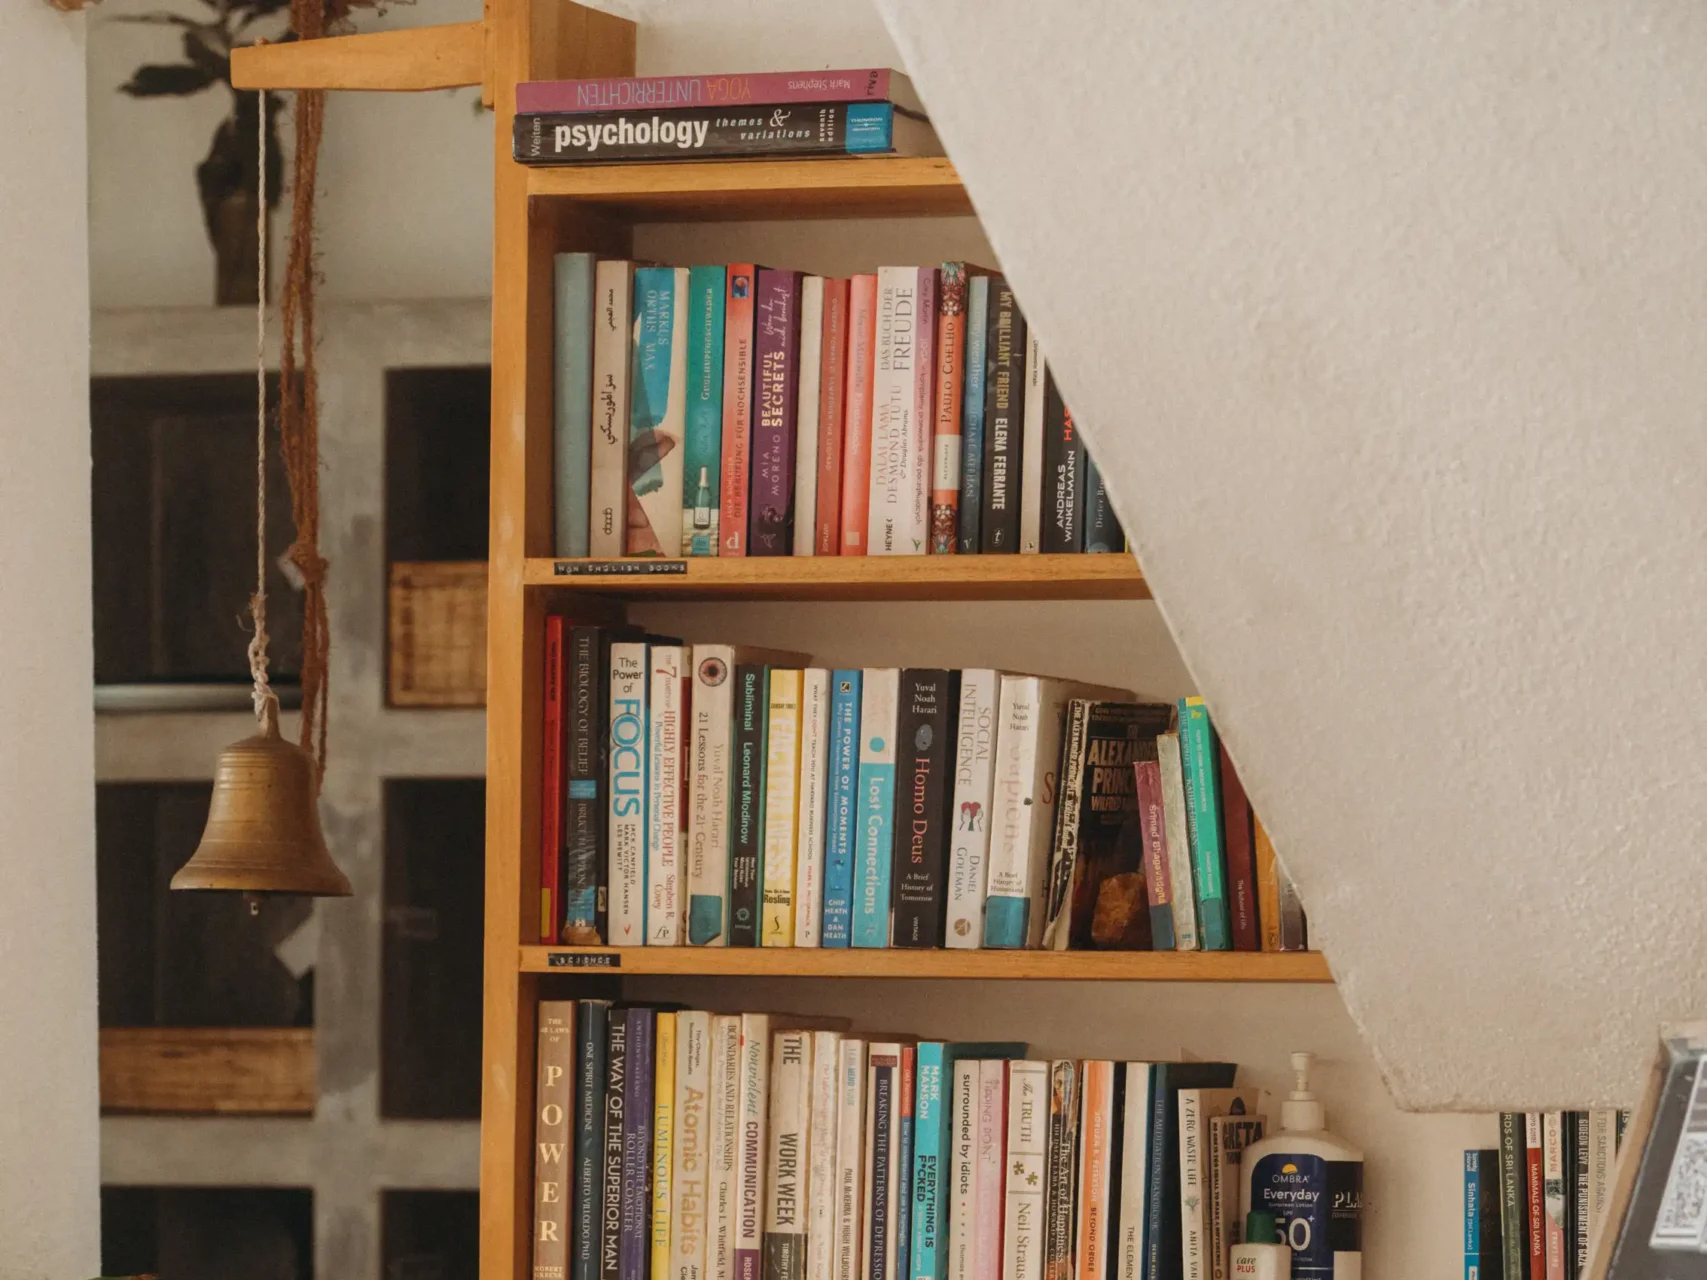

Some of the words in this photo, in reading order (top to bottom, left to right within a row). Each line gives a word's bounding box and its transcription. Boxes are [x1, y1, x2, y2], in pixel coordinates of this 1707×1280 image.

[577, 79, 700, 106] UNTERRICHTEN
[706, 78, 752, 101] YOGA
[787, 78, 823, 91] Stephens
[824, 77, 851, 90] Mark
[530, 116, 542, 156] Weiten
[554, 117, 709, 153] psychology
[715, 116, 763, 128] themes
[769, 108, 791, 127] &
[740, 127, 811, 140] variations
[658, 289, 671, 346] MARKUS
[883, 287, 893, 312] DER
[1000, 291, 1013, 307] MY
[881, 314, 892, 346] BUCH
[893, 287, 913, 372] FREUDE
[942, 322, 954, 375] COELHO
[997, 310, 1012, 366] BRILLIANT
[880, 348, 892, 371] DAS
[761, 352, 773, 428] BEAUTIFUL
[772, 351, 784, 428] SECRETS
[941, 381, 953, 424] PAULO
[995, 370, 1009, 409] FRIEND
[994, 417, 1008, 453] ELENA
[771, 433, 782, 497] MORENO
[992, 455, 1007, 511] FERRANTE
[1056, 464, 1066, 529] ANDREAS
[1065, 450, 1076, 542] WINKELMANN
[588, 562, 640, 574] ENGLISH
[577, 635, 590, 660] THE
[618, 657, 638, 668] The
[577, 663, 590, 717] BIOLOGY
[612, 668, 644, 682] Power
[914, 682, 937, 693] Yuval
[744, 673, 756, 731] Subliminal
[844, 702, 852, 723] THE
[911, 704, 938, 715] Harari
[914, 694, 936, 704] Noah
[576, 719, 589, 735] OF
[957, 683, 977, 787] INTELLIGENCE
[975, 706, 992, 765] SOCIAL
[575, 737, 589, 777] BELIEF
[613, 698, 641, 817] FOCUS
[743, 741, 755, 785] Leonard
[841, 728, 851, 771] POWER
[840, 776, 850, 791] OF
[869, 777, 885, 810] Lost
[914, 757, 930, 815] Homo
[740, 789, 753, 844] Mlodinow
[837, 796, 849, 855] MOMENTS
[911, 820, 928, 864] Deus
[864, 814, 883, 915] Connections
[952, 846, 968, 901] GOLEMAN
[967, 855, 980, 894] DANIEL
[556, 955, 611, 966] SCIENCE
[611, 1023, 625, 1051] THE
[783, 1036, 803, 1065] THE
[610, 1057, 625, 1092] WAY
[746, 1039, 762, 1117] Nonviolent
[919, 1064, 930, 1120] MANSON
[929, 1064, 940, 1100] MARK
[609, 1096, 623, 1118] OF
[608, 1123, 622, 1151] THE
[681, 1085, 704, 1173] Atomic
[539, 1065, 566, 1243] POWER
[655, 1104, 669, 1200] LUMINOUS
[779, 1132, 797, 1179] WORK
[606, 1155, 621, 1230] SUPERIOR
[742, 1120, 759, 1239] COMMUNICATION
[925, 1154, 937, 1234] EVERYTHING
[1263, 1188, 1320, 1203] Everyday
[1271, 1173, 1309, 1184] OMBRA
[680, 1179, 703, 1256] Habits
[776, 1182, 796, 1227] WEEK
[1017, 1201, 1031, 1231] Neil
[654, 1208, 668, 1248] LIFE
[925, 1235, 935, 1248] IS
[604, 1235, 618, 1270] MAN
[1236, 1256, 1257, 1265] care
[1236, 1265, 1256, 1273] PLUS
